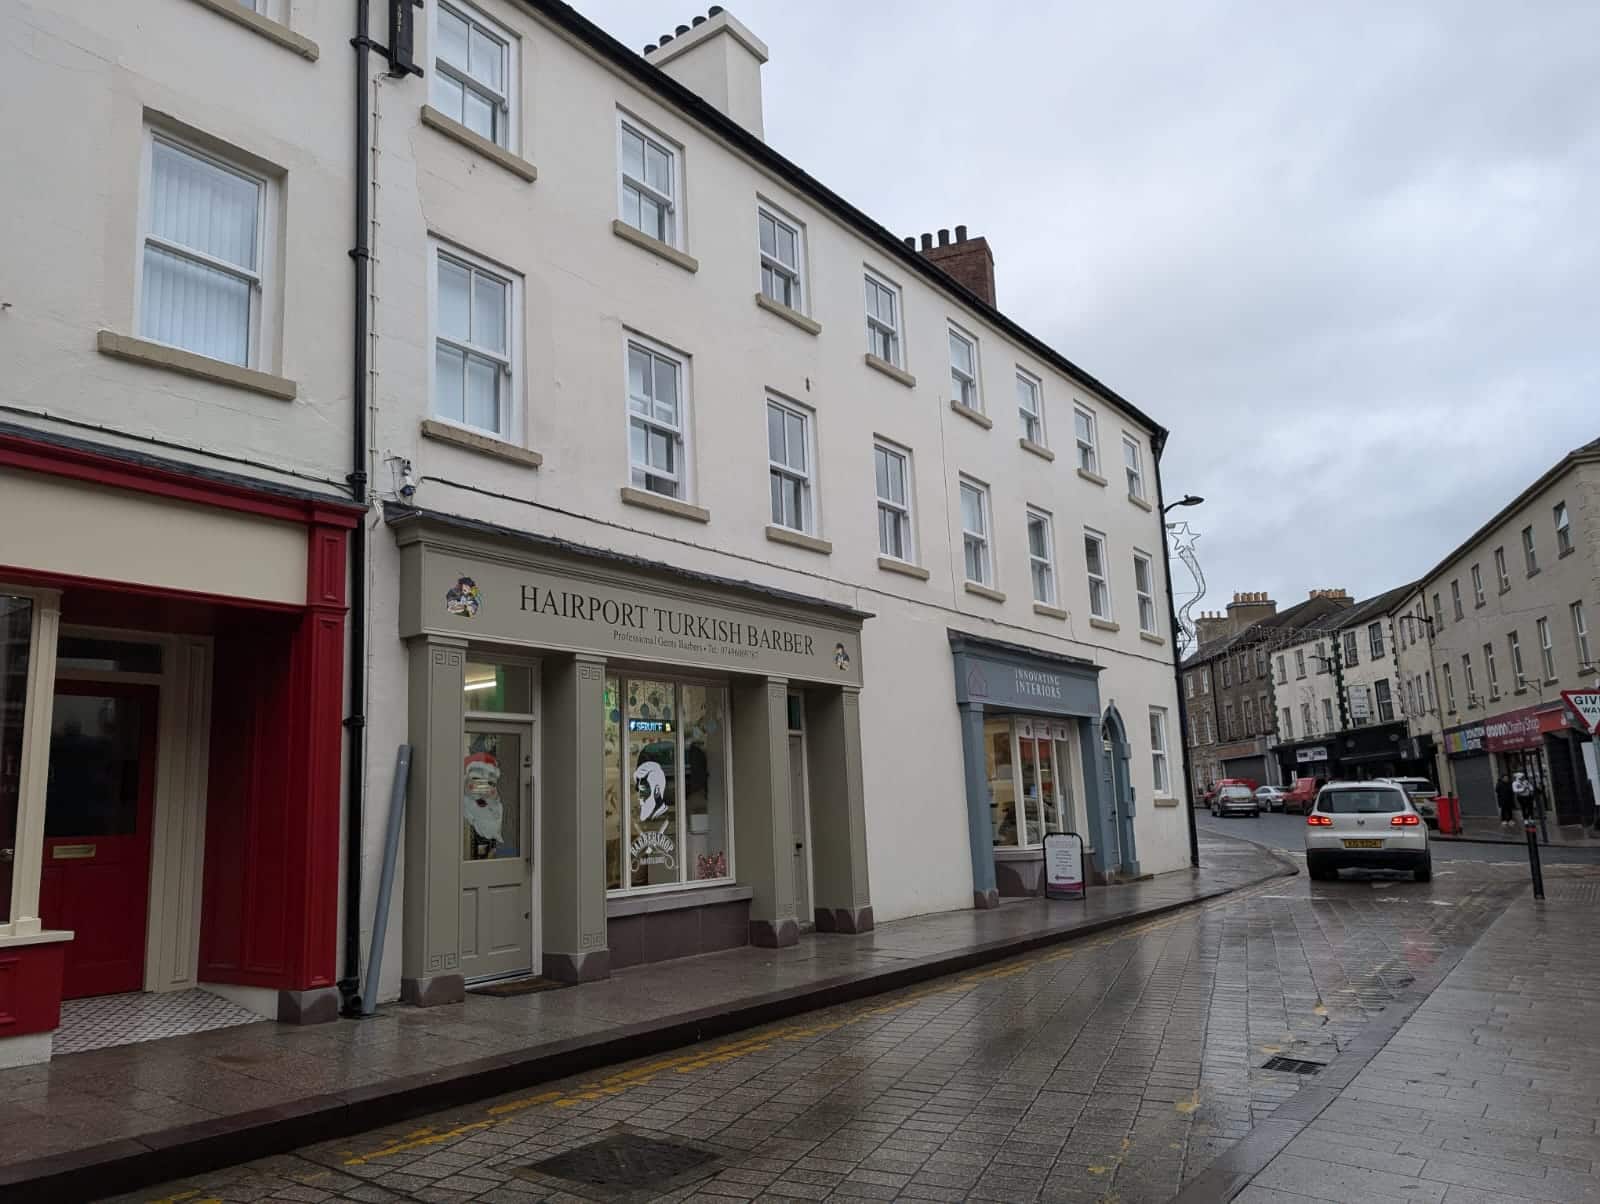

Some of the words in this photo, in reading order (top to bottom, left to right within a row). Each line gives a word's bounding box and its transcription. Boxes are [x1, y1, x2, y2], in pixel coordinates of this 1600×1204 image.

[520, 585, 648, 629] HAIRPORT
[654, 608, 741, 645] TURKISH
[747, 624, 815, 656] BARBER
[613, 631, 657, 646] Professional
[678, 639, 703, 652] Barbers
[1015, 668, 1060, 686] INNOVATING
[1015, 680, 1062, 699] INTERIORS
[1574, 695, 1600, 705] GIV
[631, 832, 674, 857] BARBERSHOP
